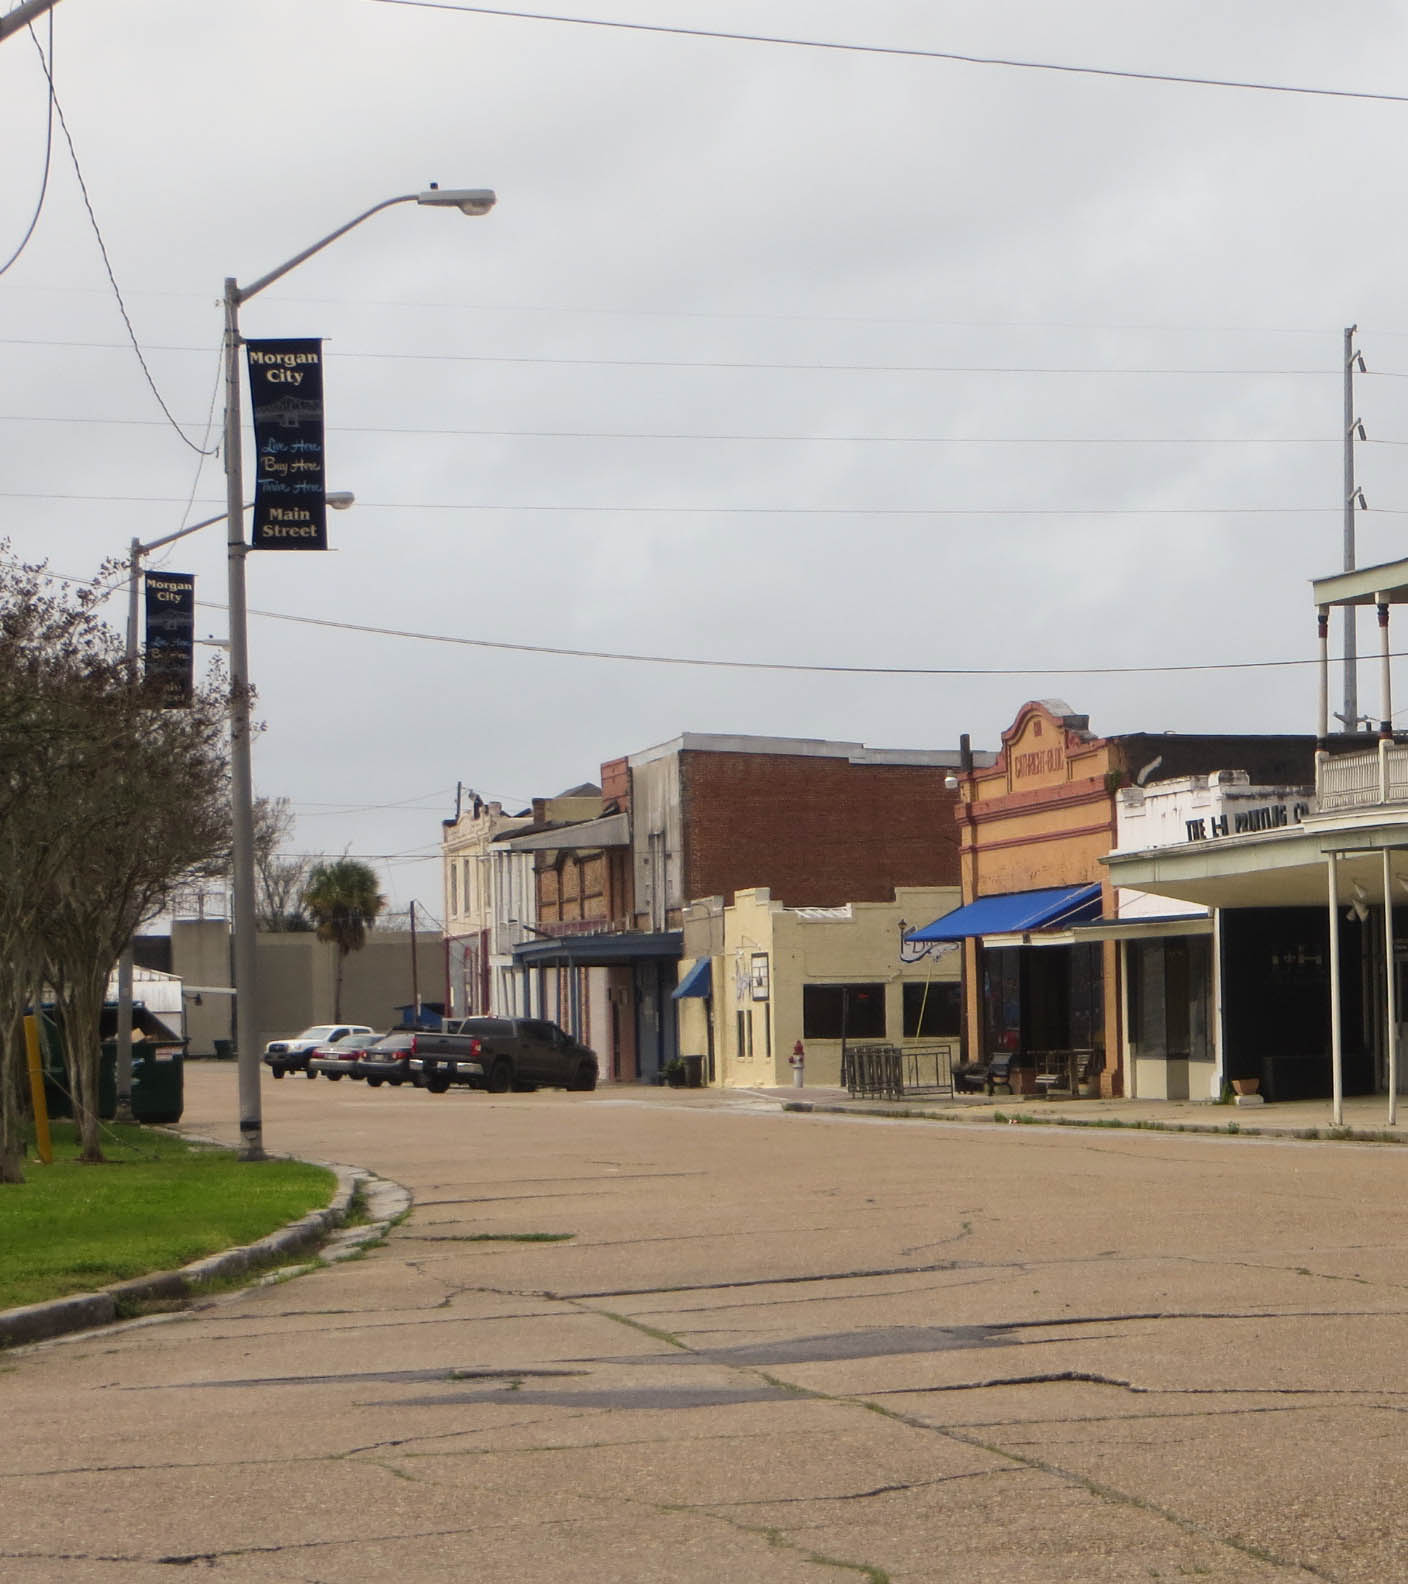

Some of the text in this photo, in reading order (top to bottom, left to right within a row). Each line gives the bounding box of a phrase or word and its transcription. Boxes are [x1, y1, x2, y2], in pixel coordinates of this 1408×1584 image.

[249, 352, 318, 368] Morgan
[266, 369, 304, 386] City
[269, 507, 310, 521] Main
[262, 524, 318, 538] Street
[147, 579, 192, 592] Morgan
[157, 591, 182, 603] City
